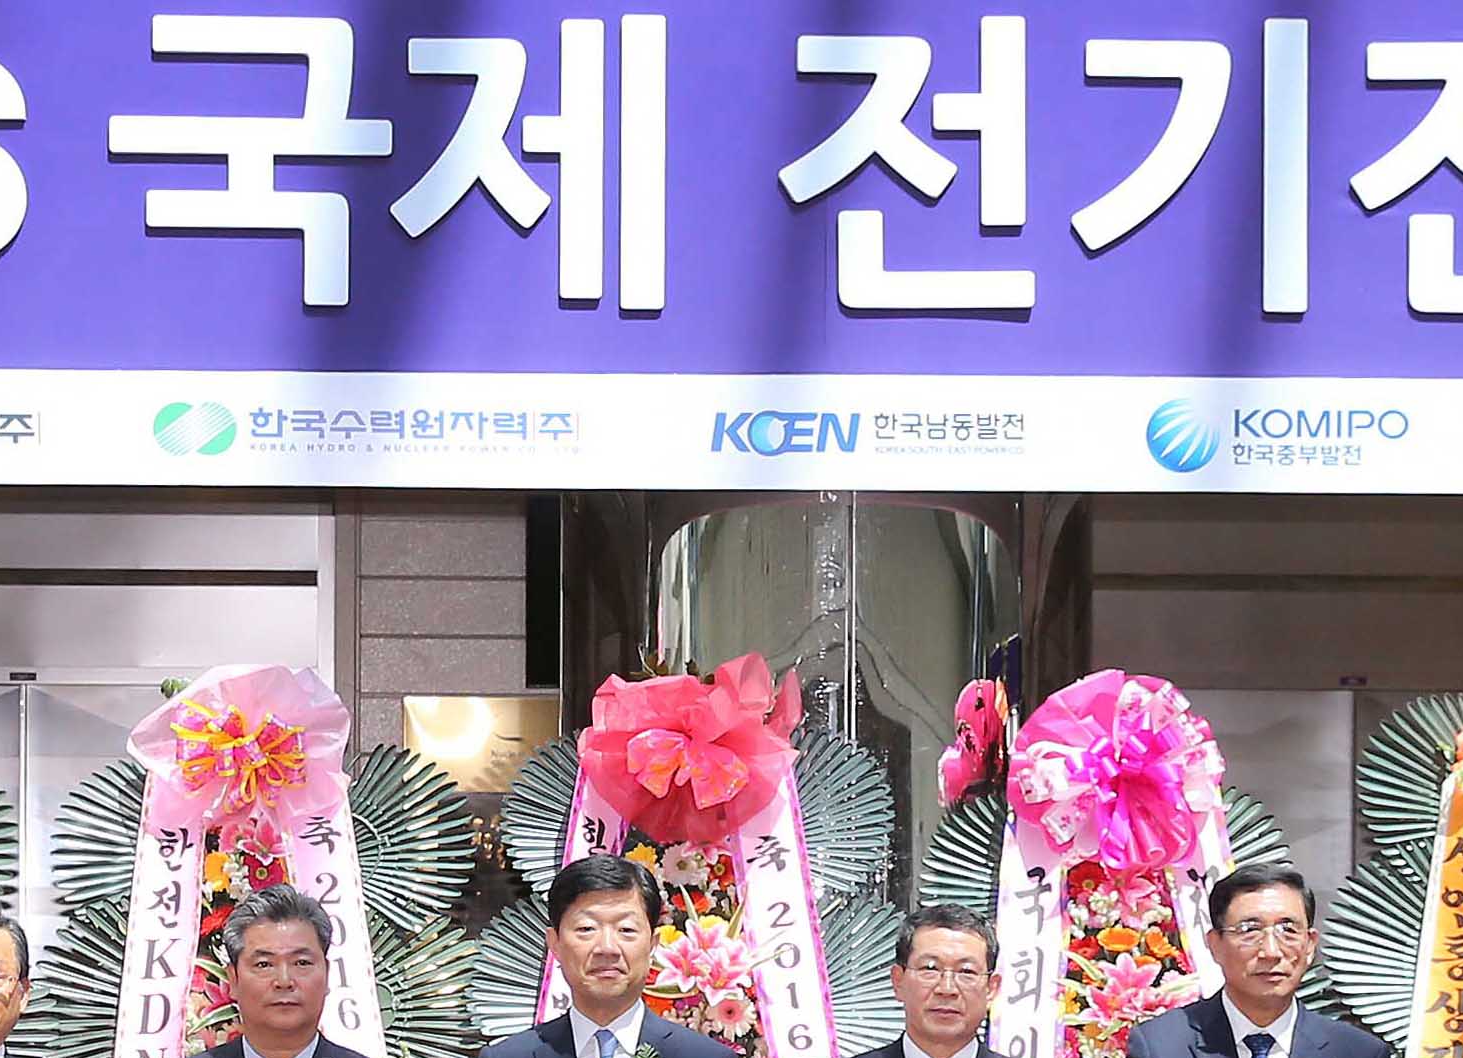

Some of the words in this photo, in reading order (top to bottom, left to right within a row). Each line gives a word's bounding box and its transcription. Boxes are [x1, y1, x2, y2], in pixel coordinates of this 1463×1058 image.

[109, 14, 666, 310] 국제
[711, 410, 861, 456] KOEN
[874, 412, 1024, 441] 한국남동발전
[1234, 409, 1409, 439] KOMIPO
[1232, 443, 1362, 466] 한국중부발전
[298, 816, 342, 854] 축
